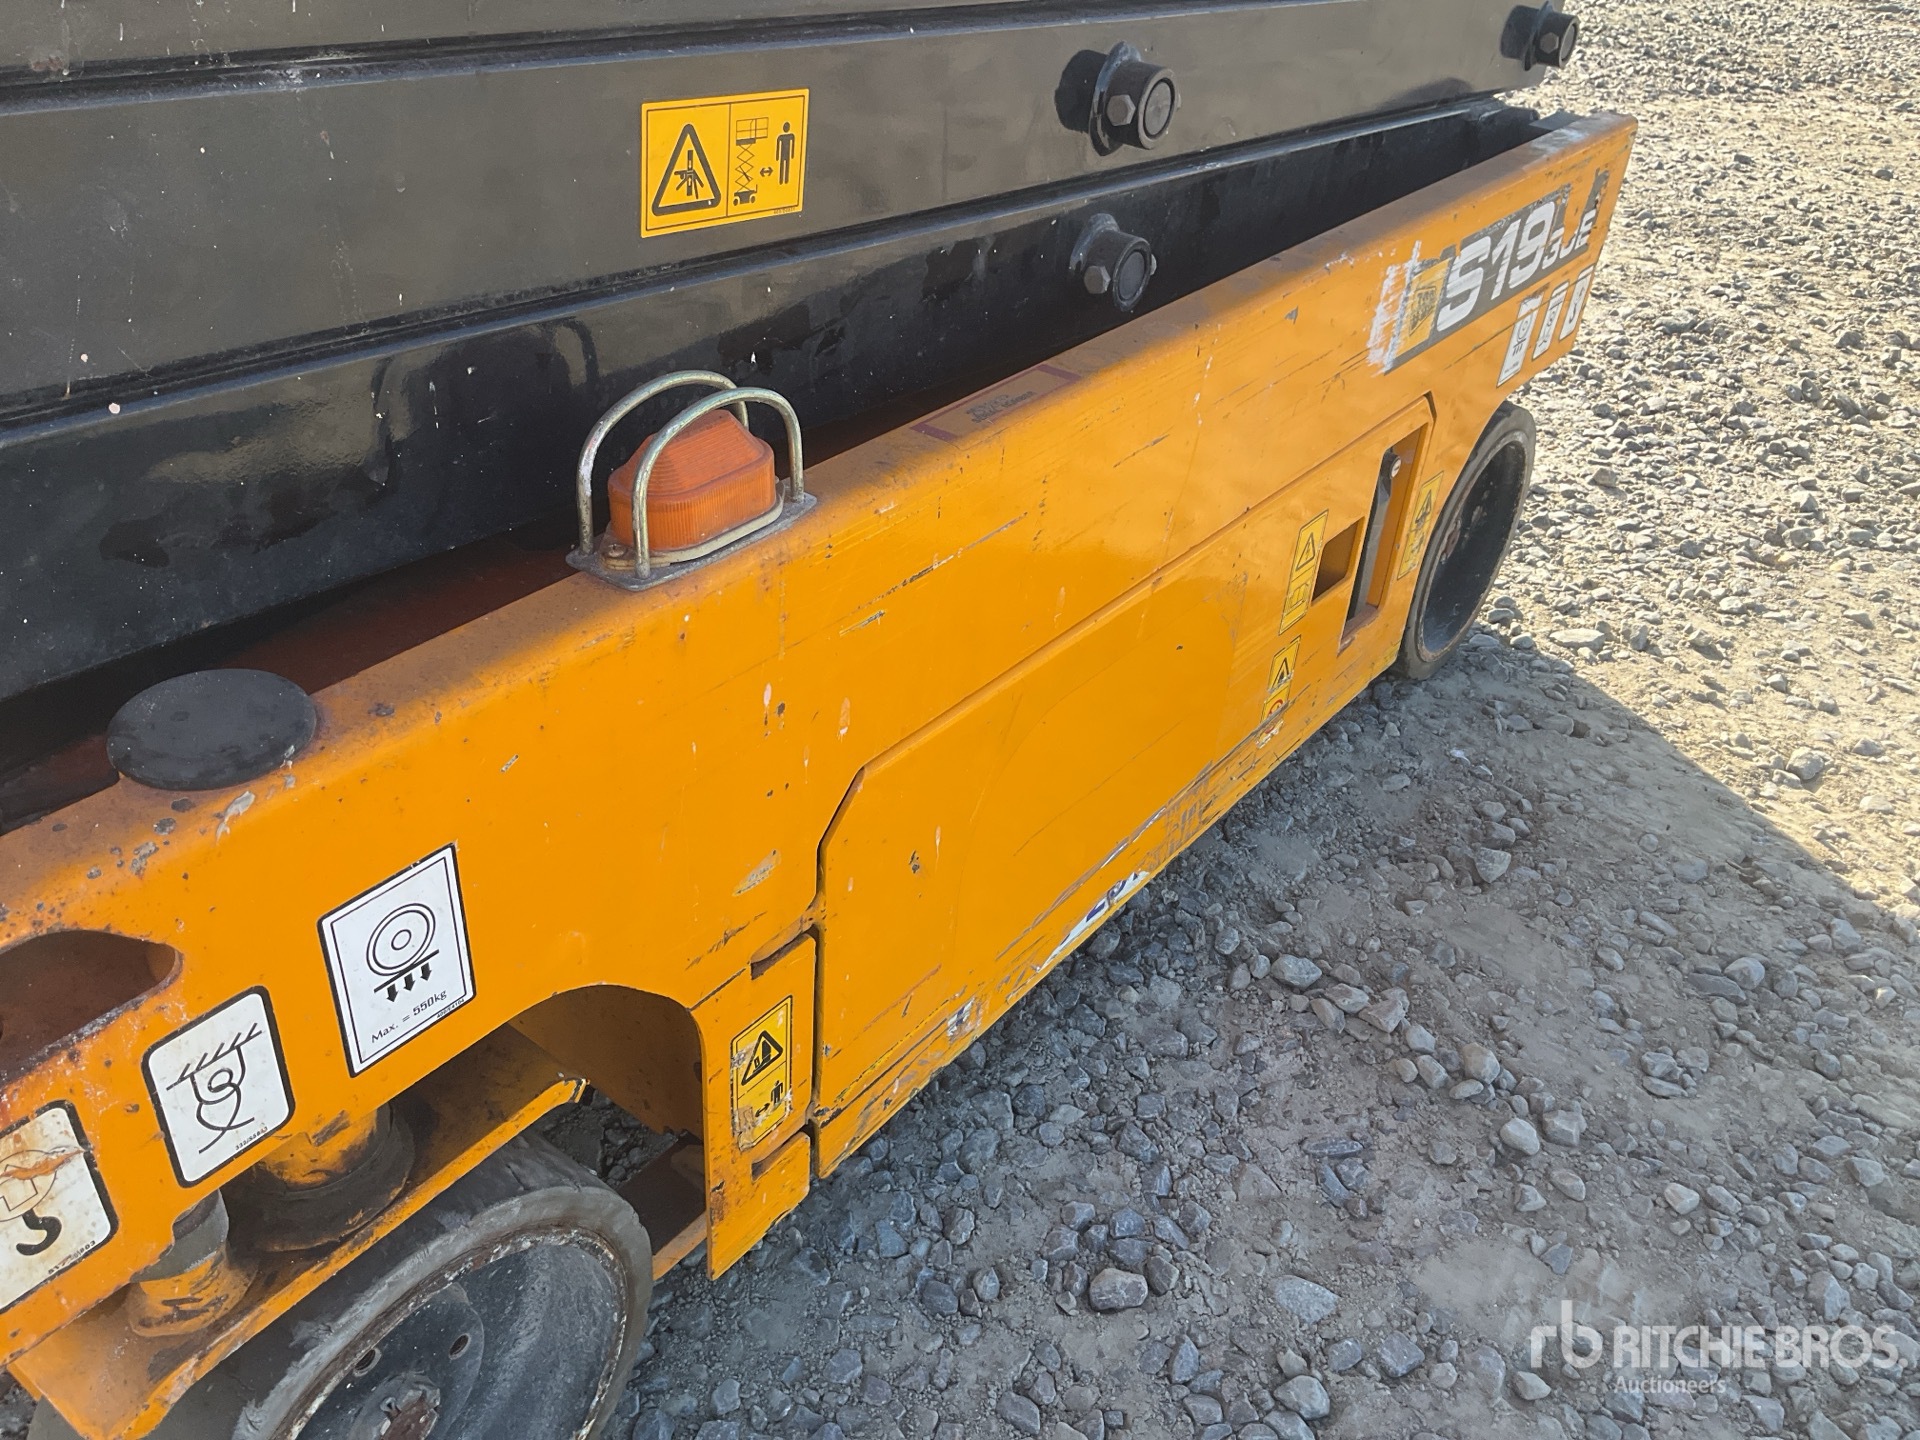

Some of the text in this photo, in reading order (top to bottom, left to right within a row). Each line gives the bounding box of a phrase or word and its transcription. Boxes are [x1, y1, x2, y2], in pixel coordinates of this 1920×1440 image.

[371, 990, 447, 1043] Max. = 550kg
